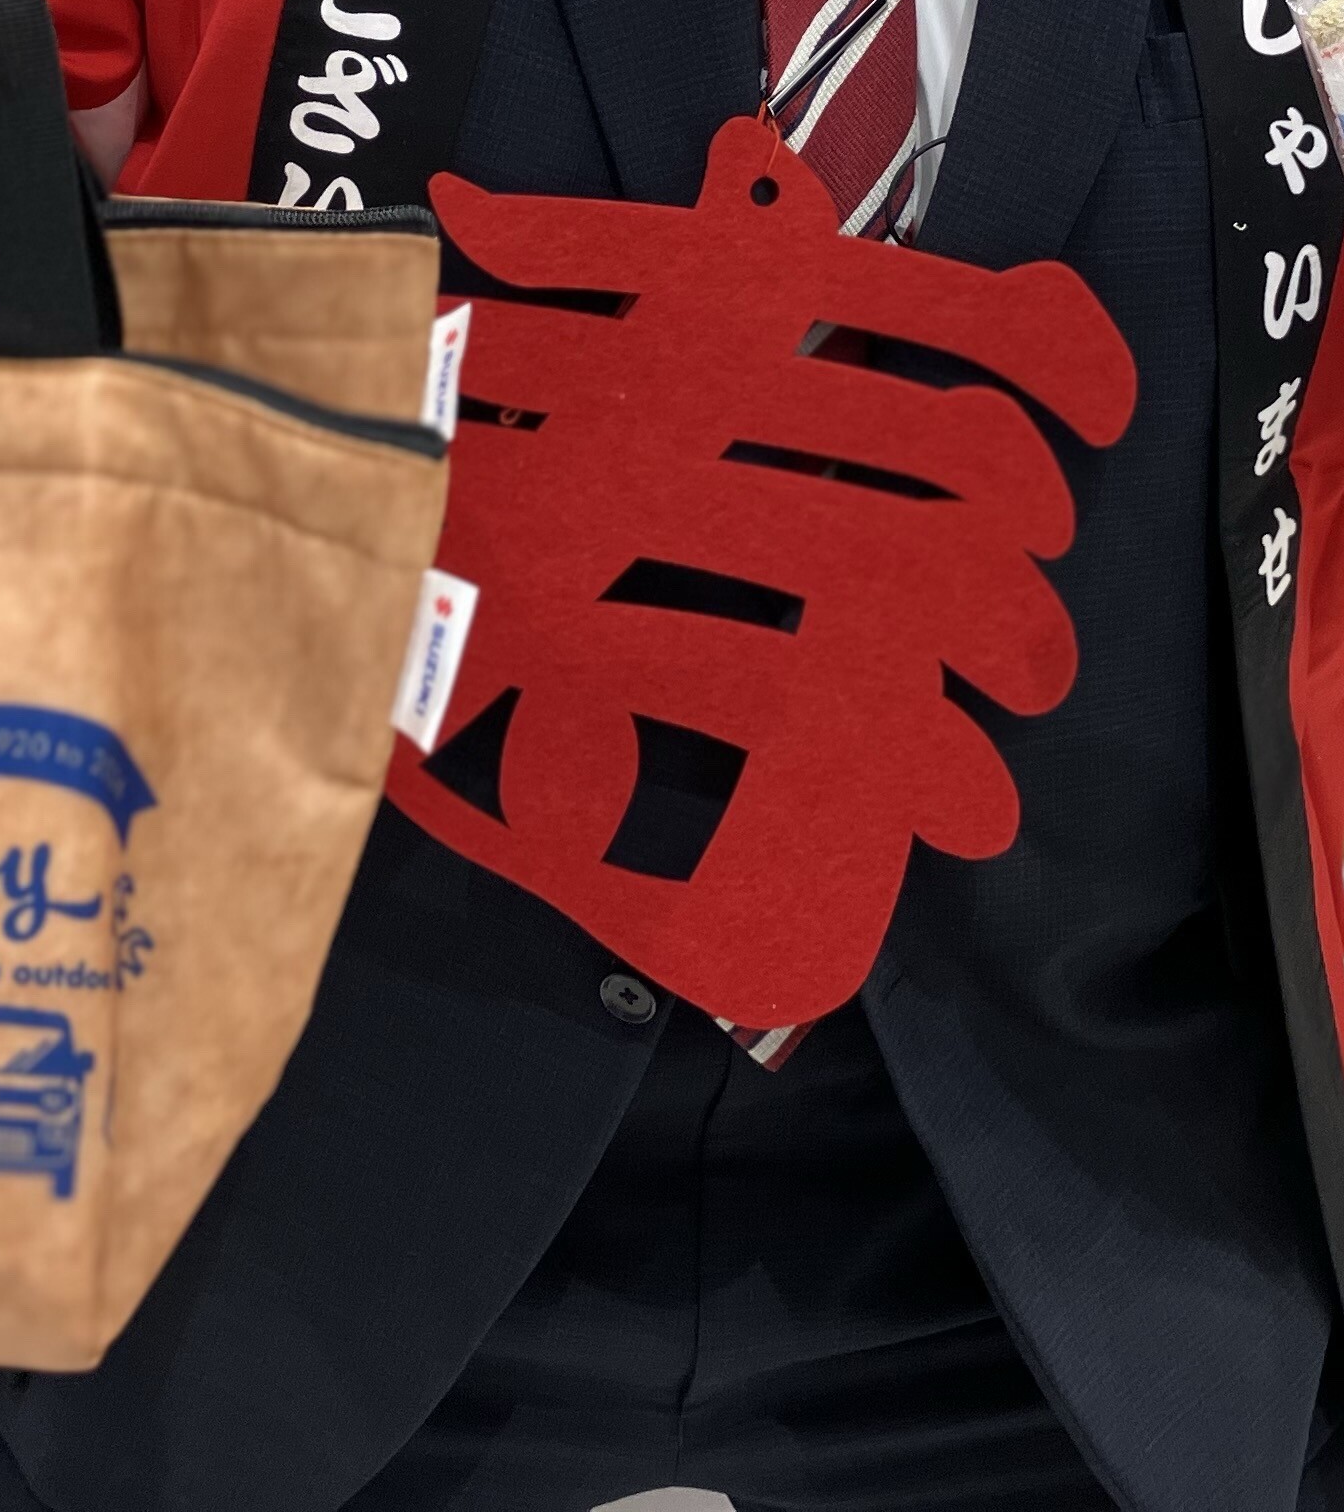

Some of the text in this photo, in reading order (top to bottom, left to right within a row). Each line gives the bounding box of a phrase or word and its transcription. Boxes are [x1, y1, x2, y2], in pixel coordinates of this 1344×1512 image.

[436, 349, 455, 422] SUZUK
[415, 622, 447, 718] SUZUKI
[56, 741, 85, 769] to
